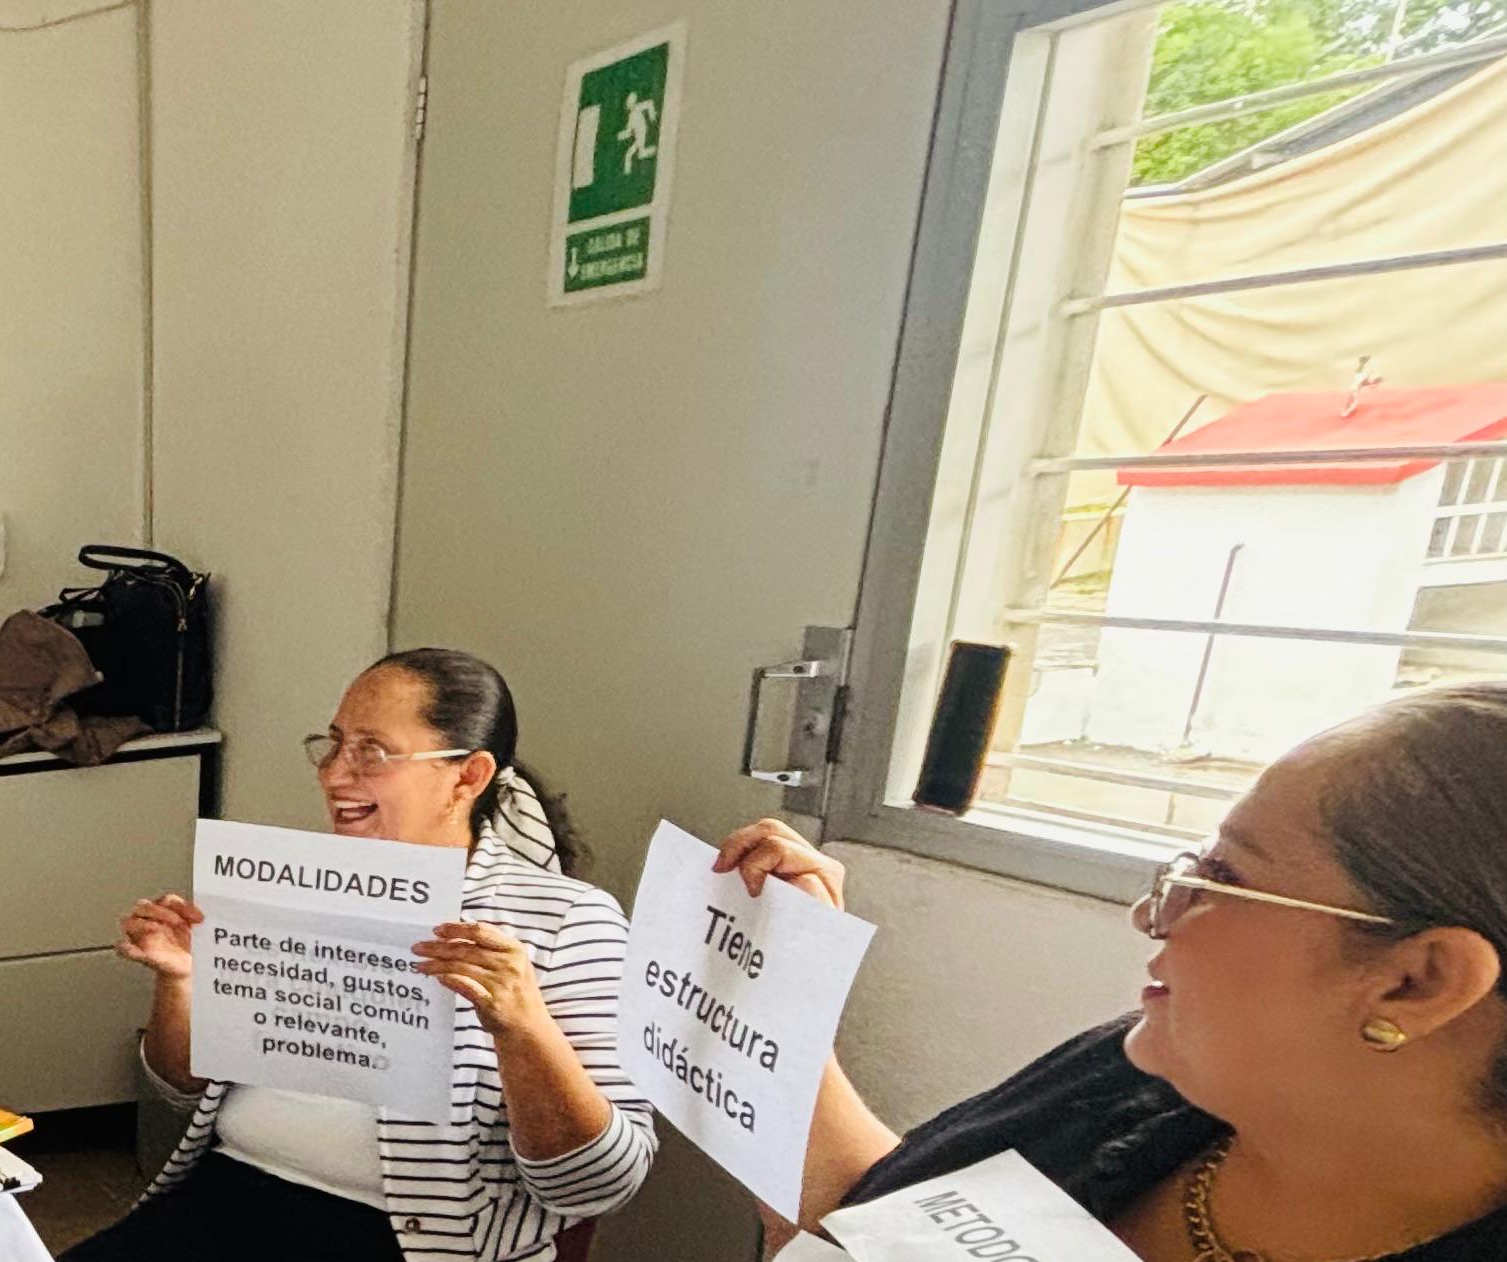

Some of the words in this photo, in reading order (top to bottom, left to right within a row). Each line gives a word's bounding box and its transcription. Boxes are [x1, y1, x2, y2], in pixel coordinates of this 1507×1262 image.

[214, 854, 431, 904] MODALIDADES
[214, 928, 271, 951] Parte
[280, 936, 306, 955] de
[704, 905, 764, 980] Tiene
[213, 978, 267, 1001] tema
[275, 988, 341, 1012] social
[350, 1001, 429, 1030] común
[214, 955, 335, 988] necesidad,
[343, 975, 430, 1006] gustos,
[254, 1011, 267, 1025] o
[275, 1013, 387, 1049] relevante,
[645, 960, 780, 1073] estructura
[643, 1021, 757, 1134] didáctica
